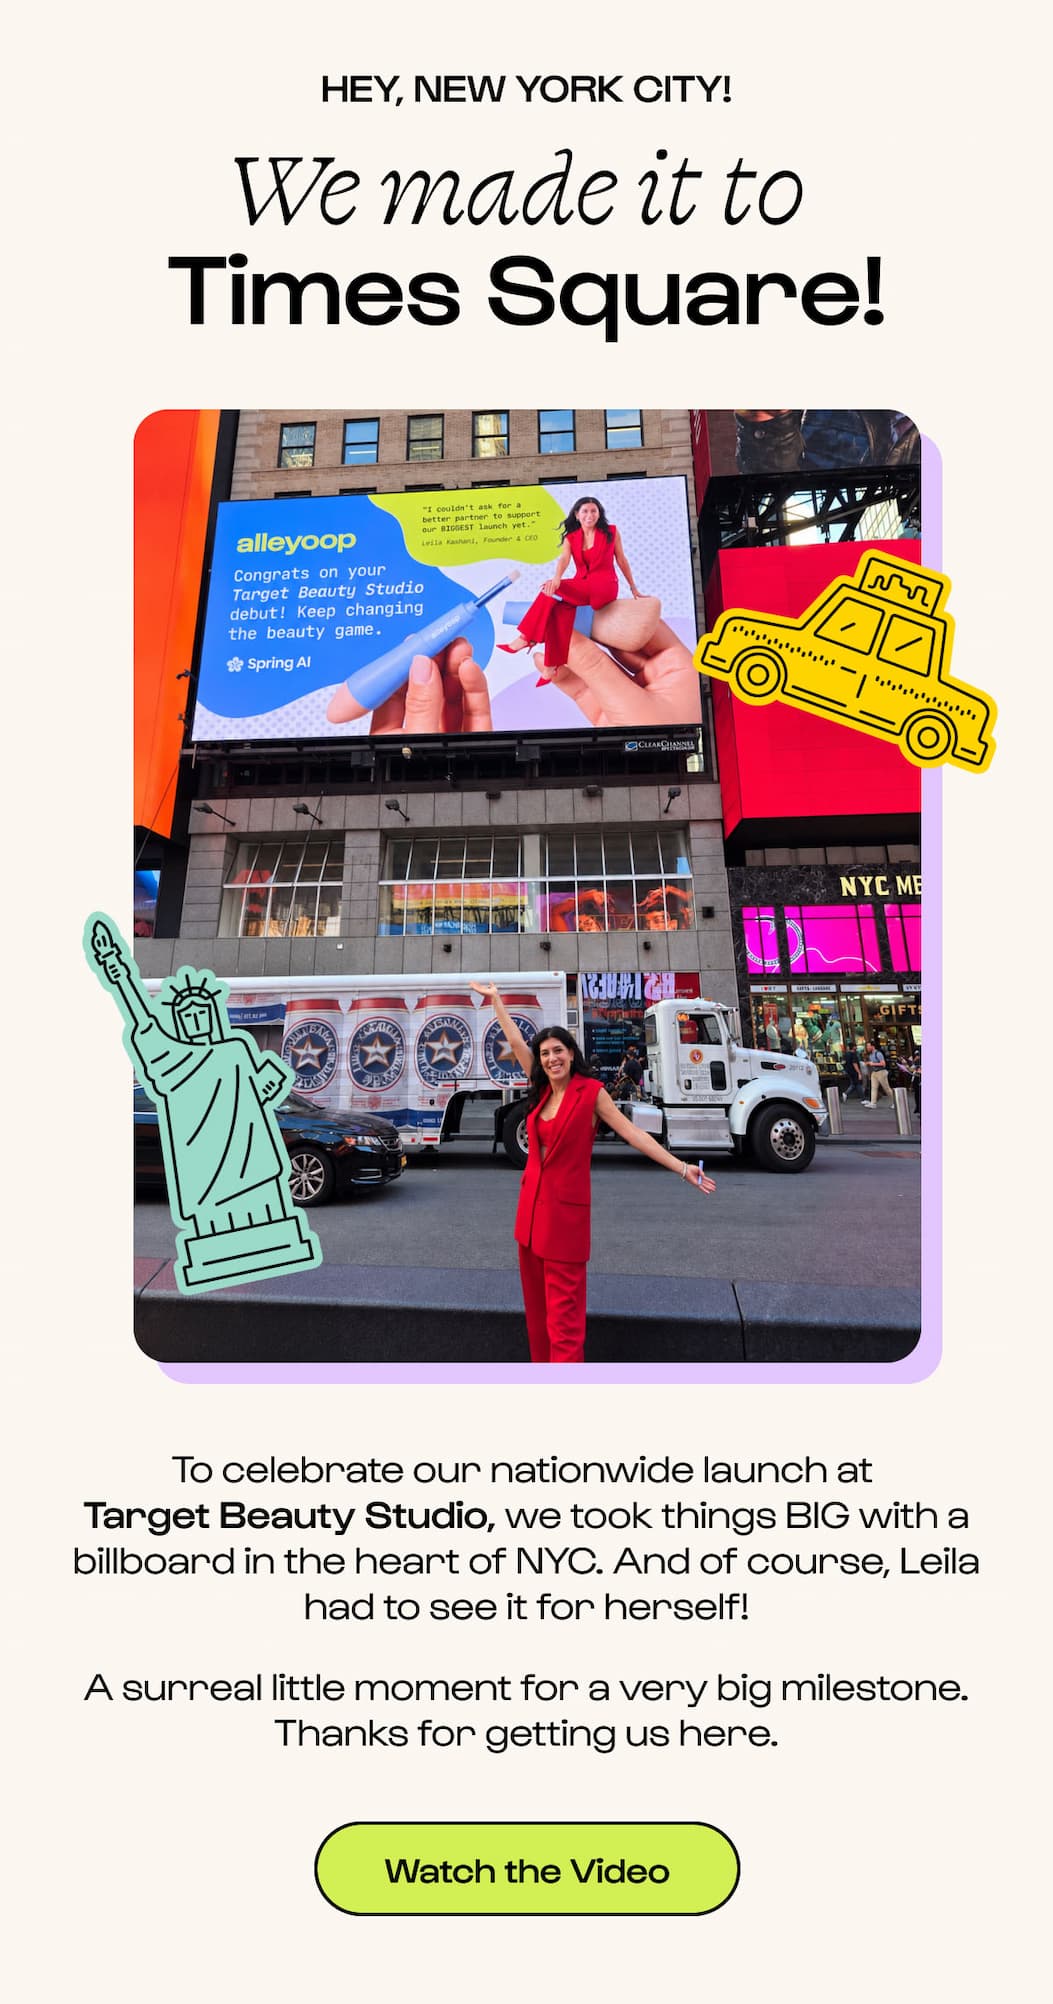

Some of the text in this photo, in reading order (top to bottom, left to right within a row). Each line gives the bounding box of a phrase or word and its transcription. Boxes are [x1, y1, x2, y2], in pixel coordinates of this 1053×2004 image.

[436, 504, 473, 513] couldn't
[498, 502, 511, 510] for
[455, 513, 488, 522] partner
[507, 511, 541, 519] support
[441, 524, 474, 532] BIGGEST
[479, 522, 508, 530] launch
[236, 532, 357, 555] alleyoop
[233, 565, 386, 583] Congrats on your
[233, 581, 424, 602] Target Beauty Studio
[230, 602, 424, 621] debut! Keep changing
[229, 625, 382, 641] the beauty game.
[247, 656, 311, 673] Spring AI
[840, 876, 889, 896] NYC
